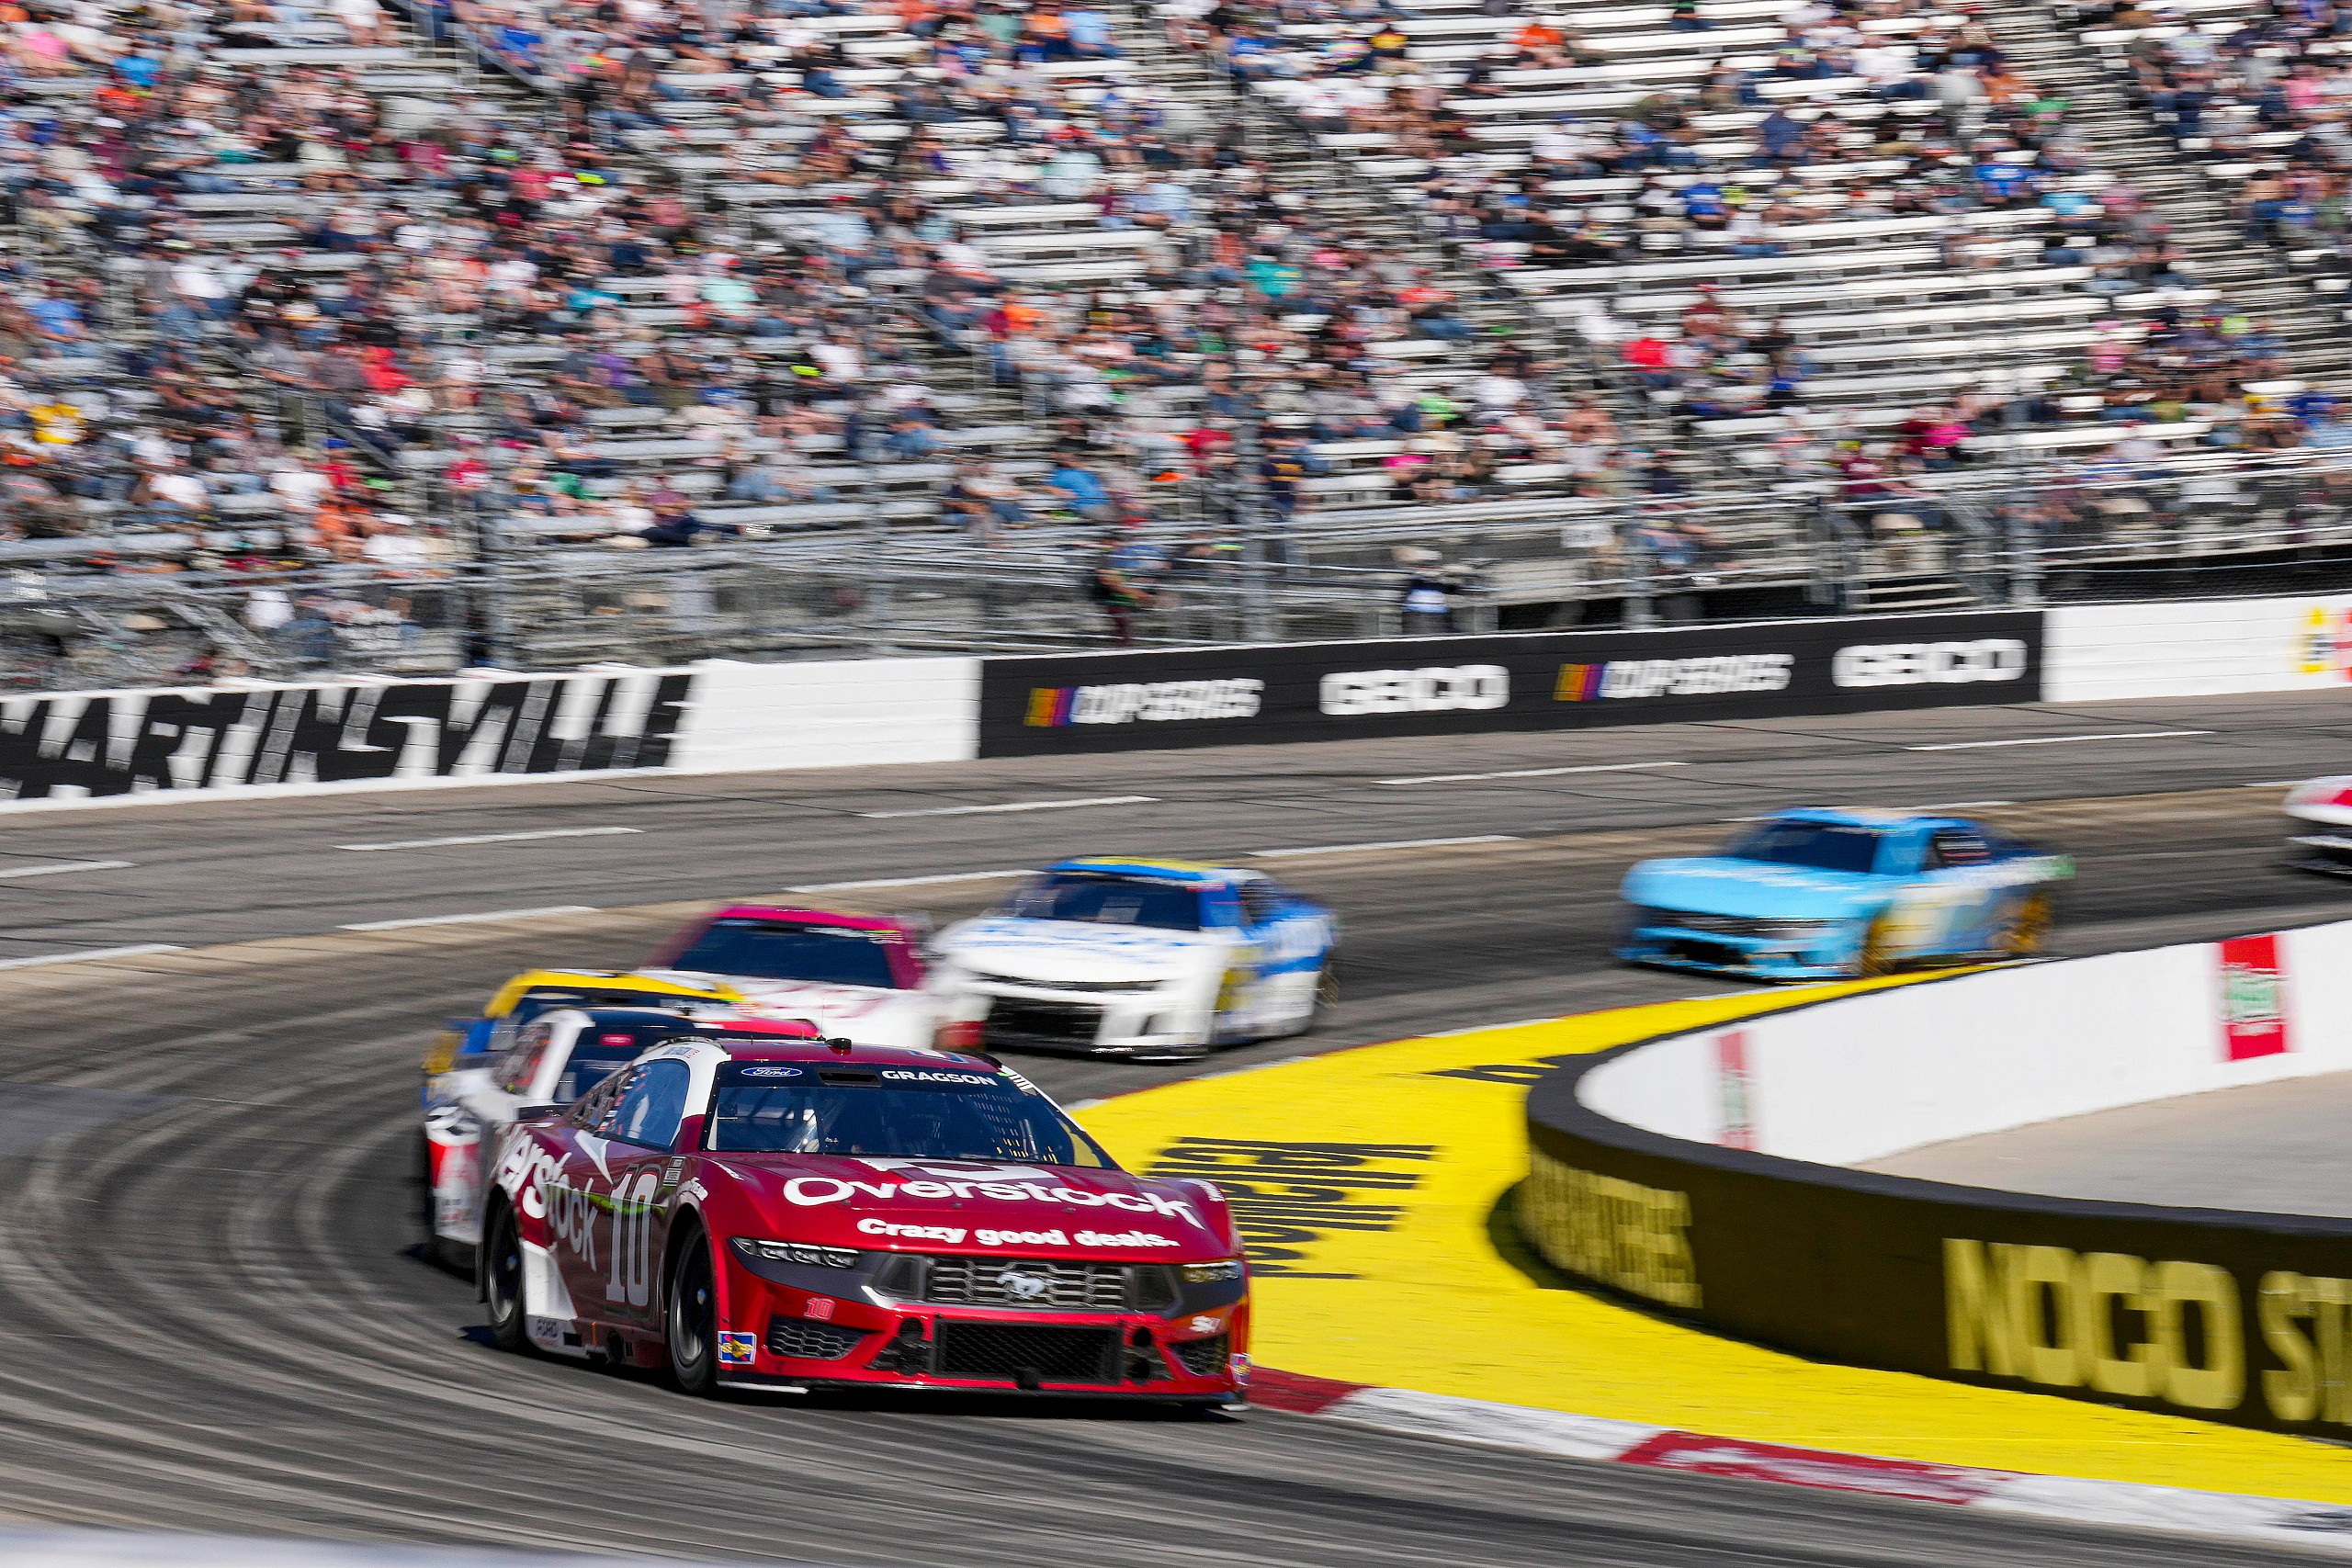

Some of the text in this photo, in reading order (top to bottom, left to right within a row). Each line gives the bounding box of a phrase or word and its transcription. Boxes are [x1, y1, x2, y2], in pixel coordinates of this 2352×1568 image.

[881, 1070, 999, 1087] GRAGSON
[783, 1177, 1206, 1230] Overstock
[607, 1165, 661, 1315] 10
[856, 1217, 1182, 1247] Crazy good deals.
[804, 1297, 836, 1320] 10
[1941, 1237, 2247, 1410] NOCO
